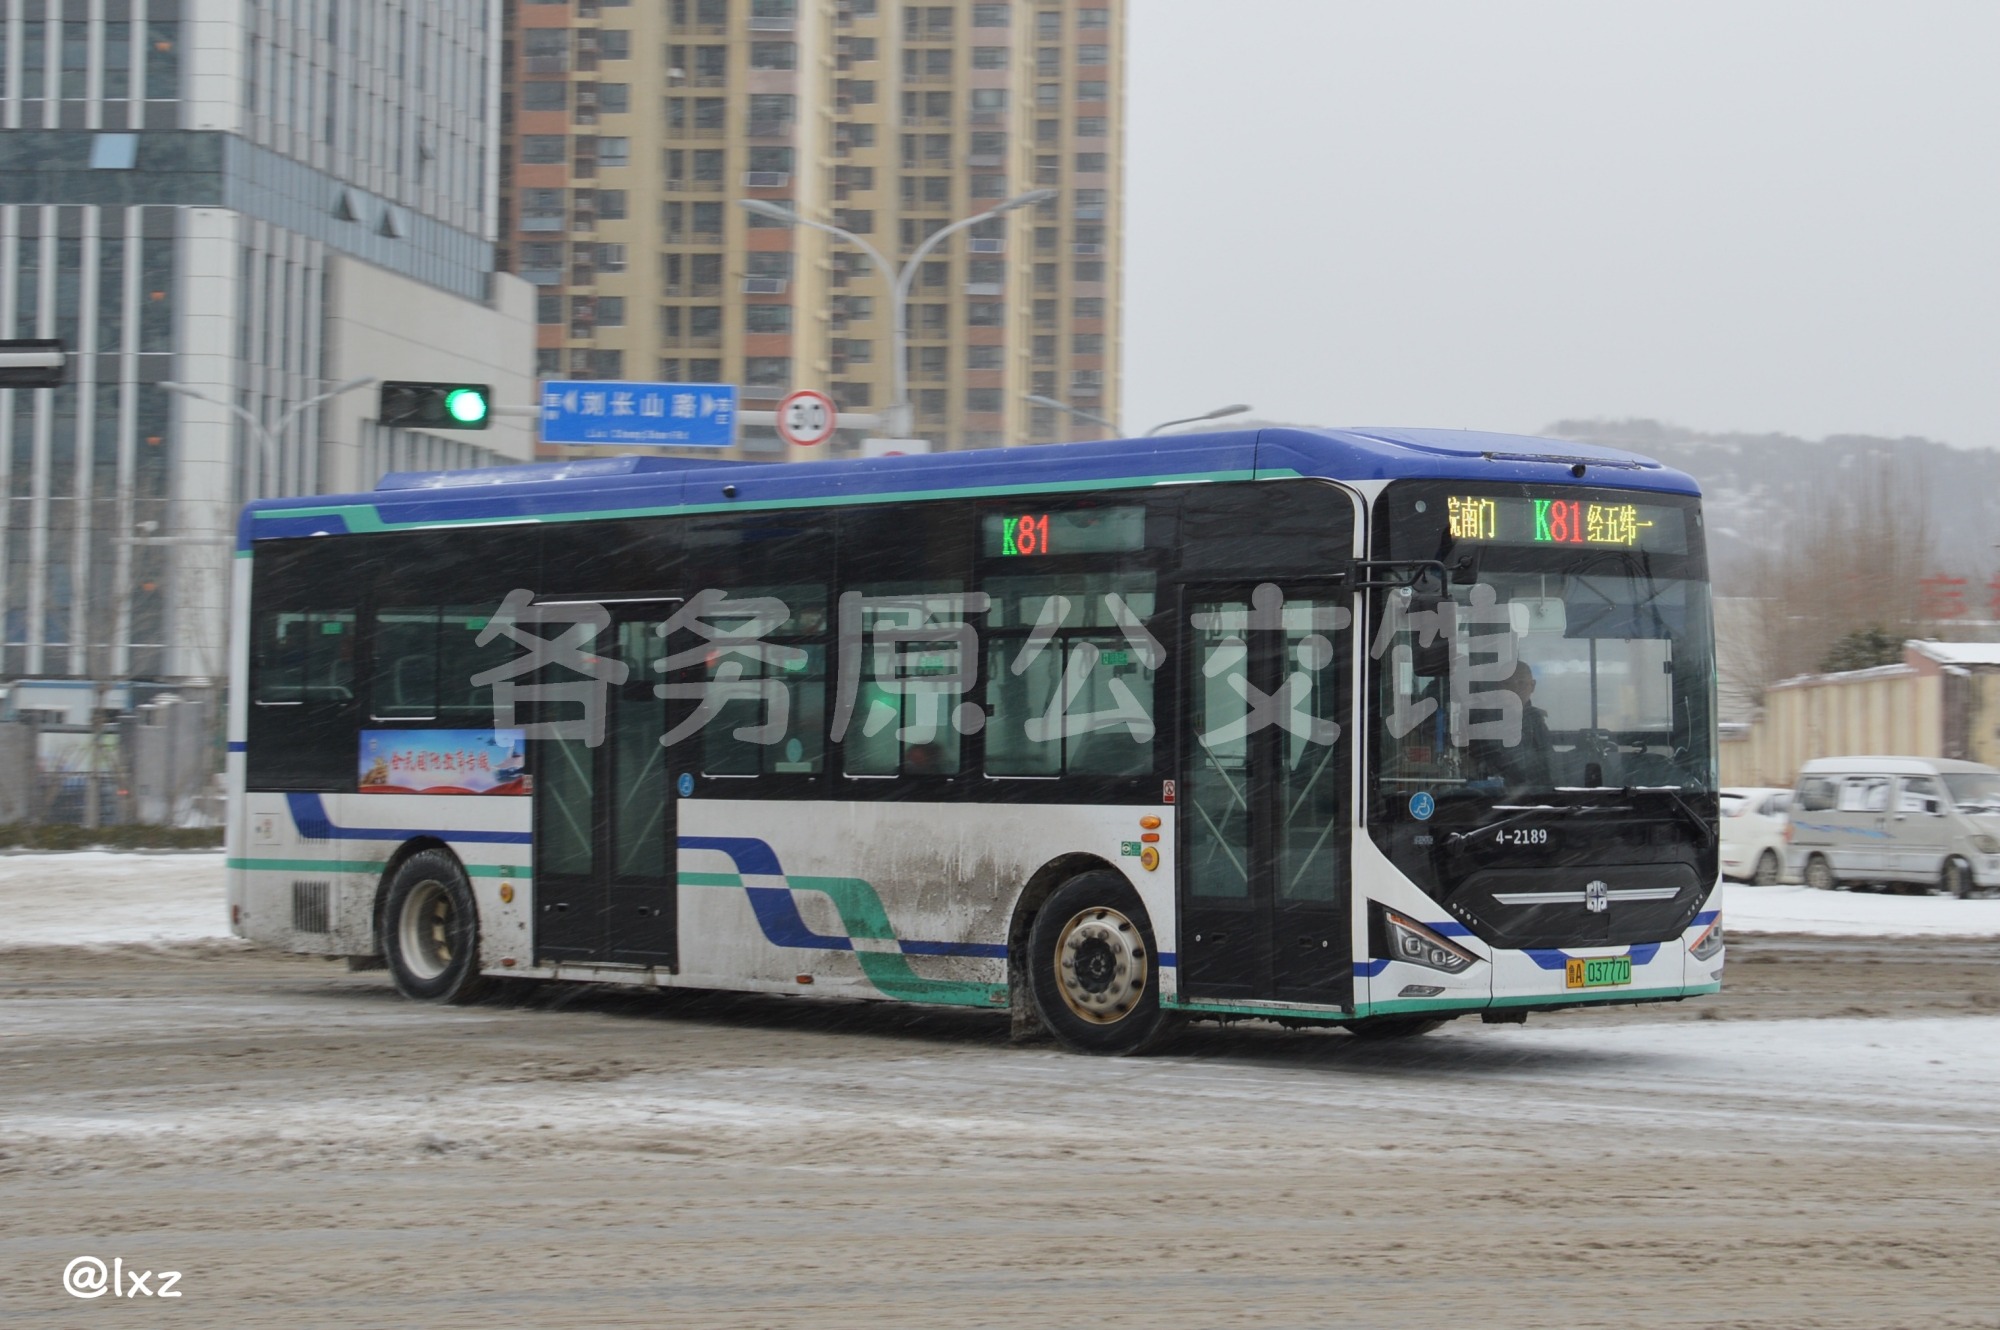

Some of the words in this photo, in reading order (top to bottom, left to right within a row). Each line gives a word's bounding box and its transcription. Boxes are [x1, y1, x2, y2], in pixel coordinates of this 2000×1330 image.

[582, 391, 696, 419] 刘长山路
[1002, 514, 1049, 555] K81
[1534, 500, 1582, 542] K81
[1587, 504, 1653, 546] 经五纬一
[1496, 829, 1548, 845] 4-2189
